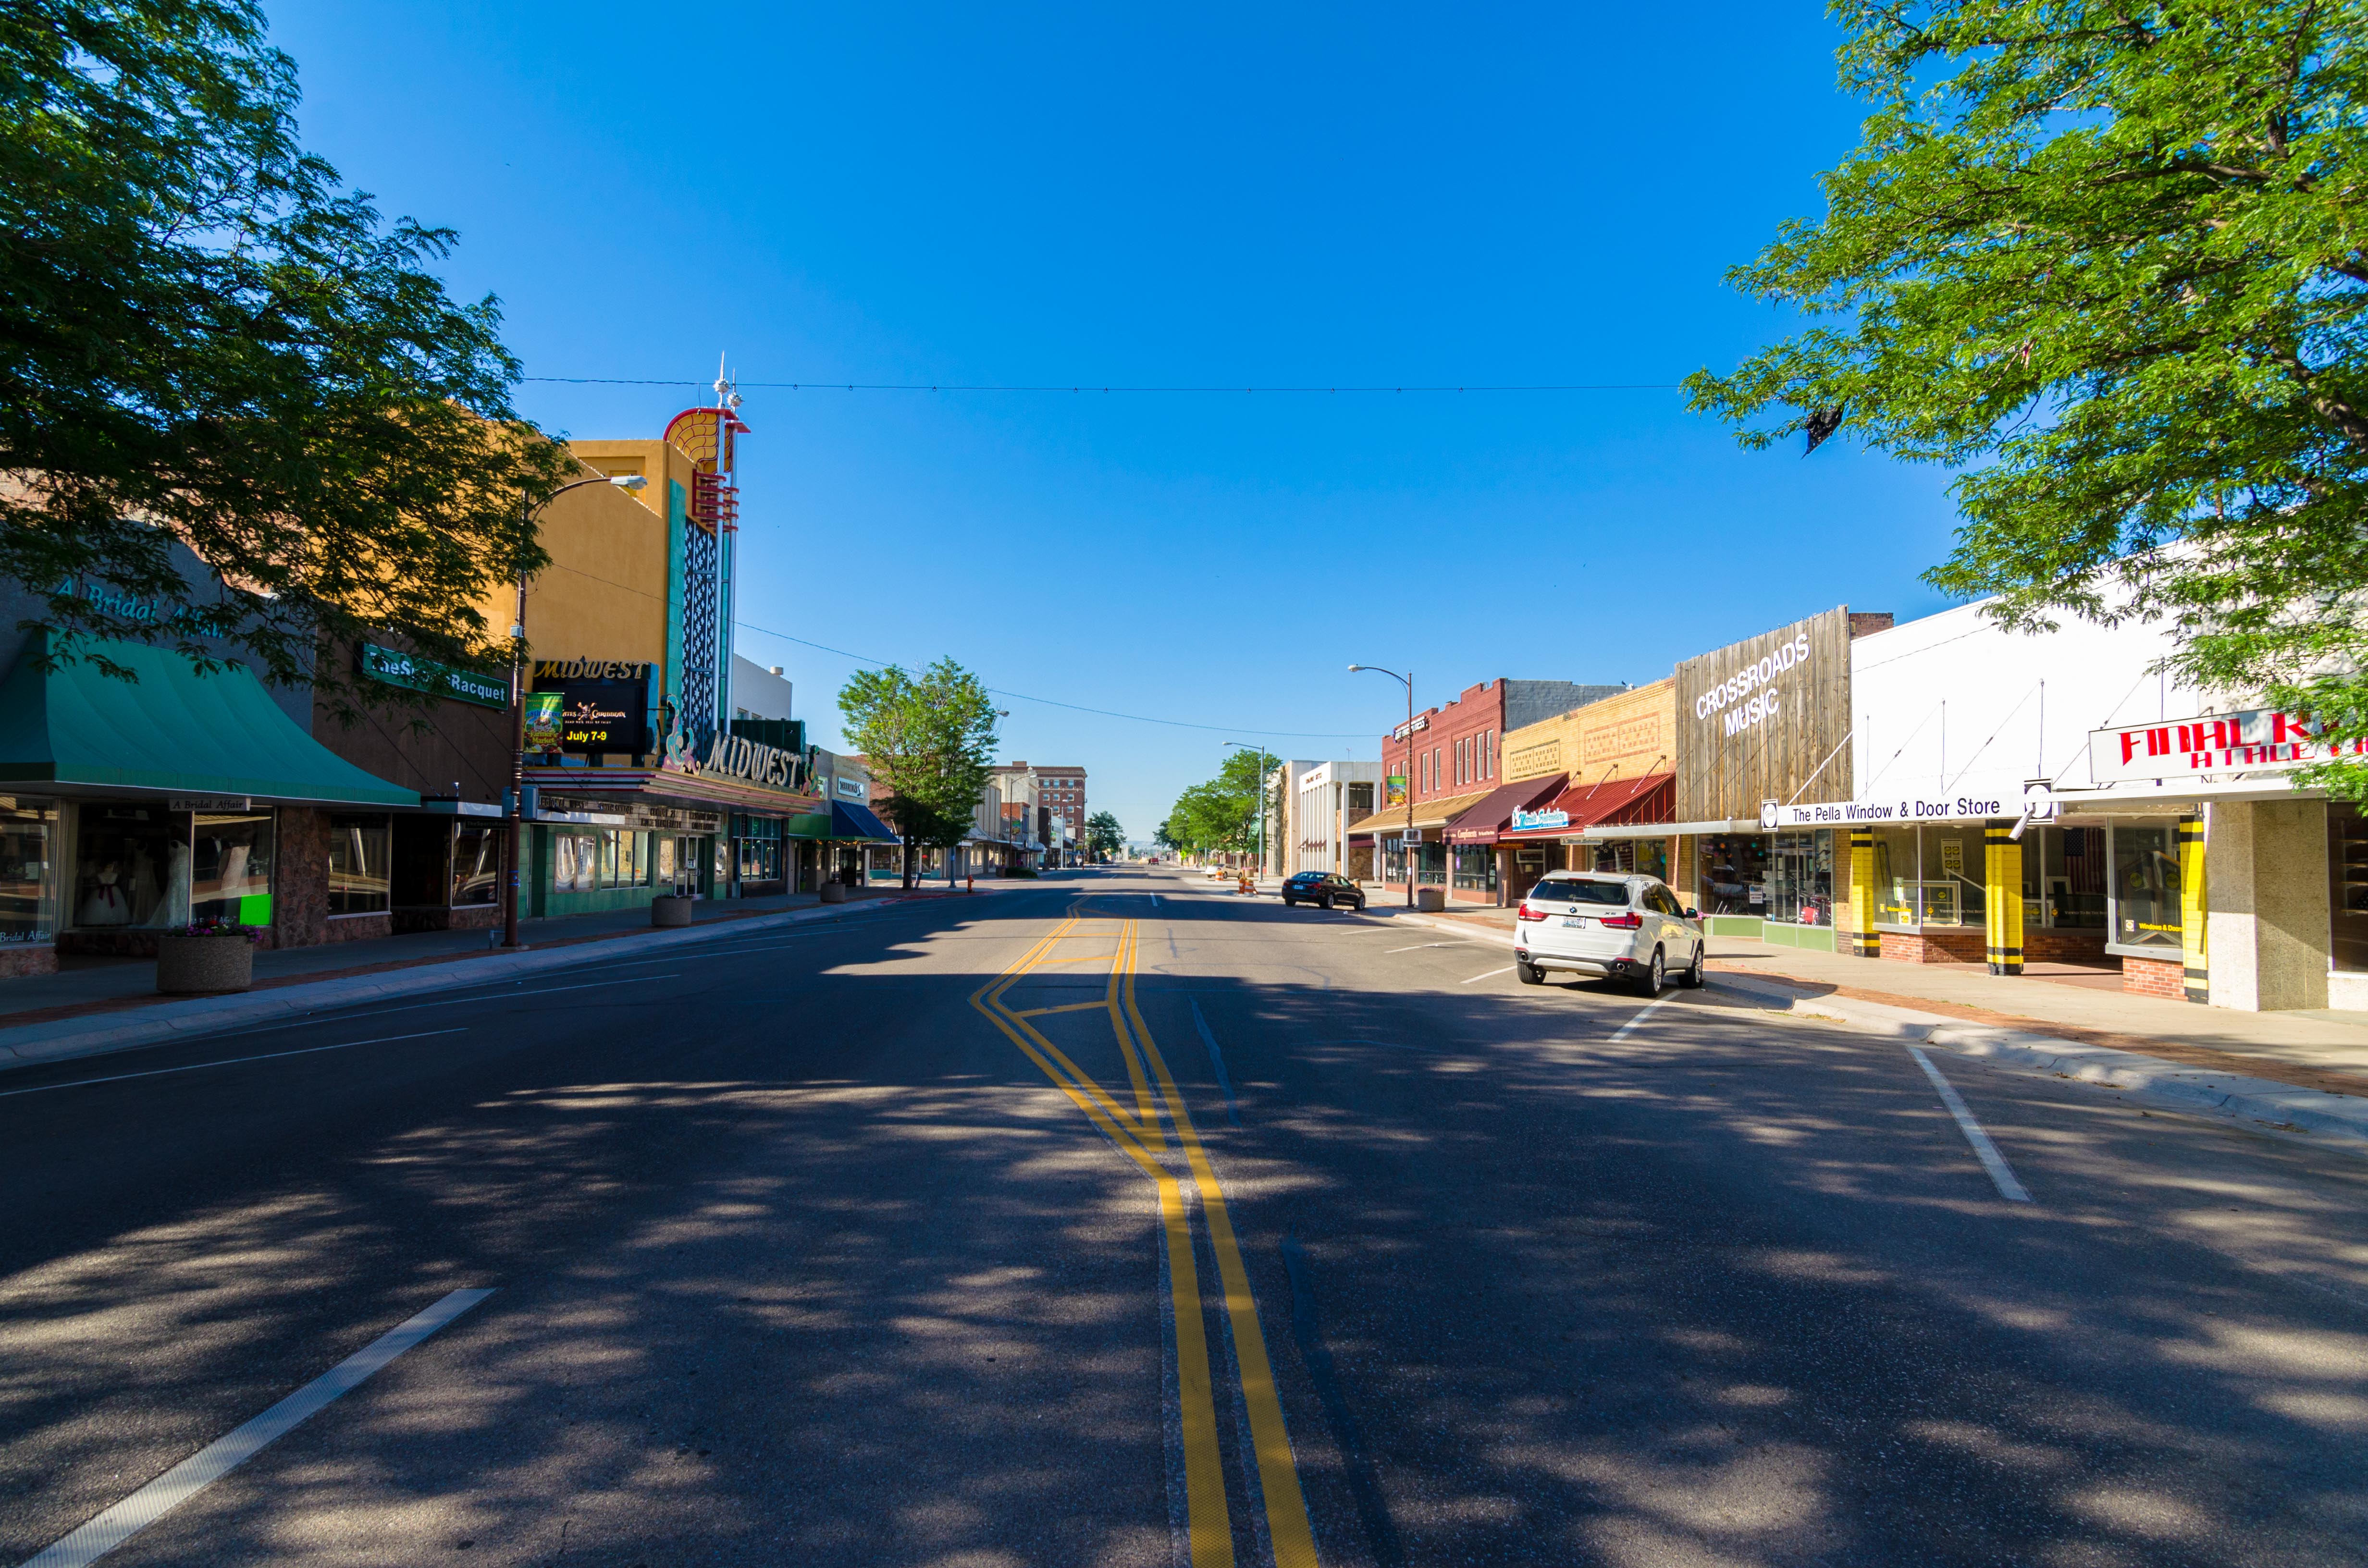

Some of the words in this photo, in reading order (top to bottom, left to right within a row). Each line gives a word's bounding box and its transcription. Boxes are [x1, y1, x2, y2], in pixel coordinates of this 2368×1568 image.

[55, 576, 73, 596] A
[86, 583, 158, 624] Bridal
[534, 661, 649, 679] MIDWEST
[1696, 633, 1810, 720] CROSSROADS
[1724, 687, 1780, 737] MUSIC
[567, 731, 589, 743] July
[591, 731, 607, 741] 7-9
[2117, 718, 2261, 767] FINAL
[704, 730, 802, 788] MIDWEST
[173, 800, 180, 808] A
[185, 800, 212, 808] Bridal
[216, 800, 244, 810] Affair
[1793, 808, 1811, 822] The
[1815, 807, 1841, 821] Pella
[1846, 804, 1893, 820] Window
[1900, 802, 1909, 818] &
[1916, 800, 1950, 816] Door
[1957, 797, 2000, 814] Store
[1457, 829, 1477, 841] Compliments
[0, 931, 25, 943] Bridal
[27, 930, 51, 942] Affair
